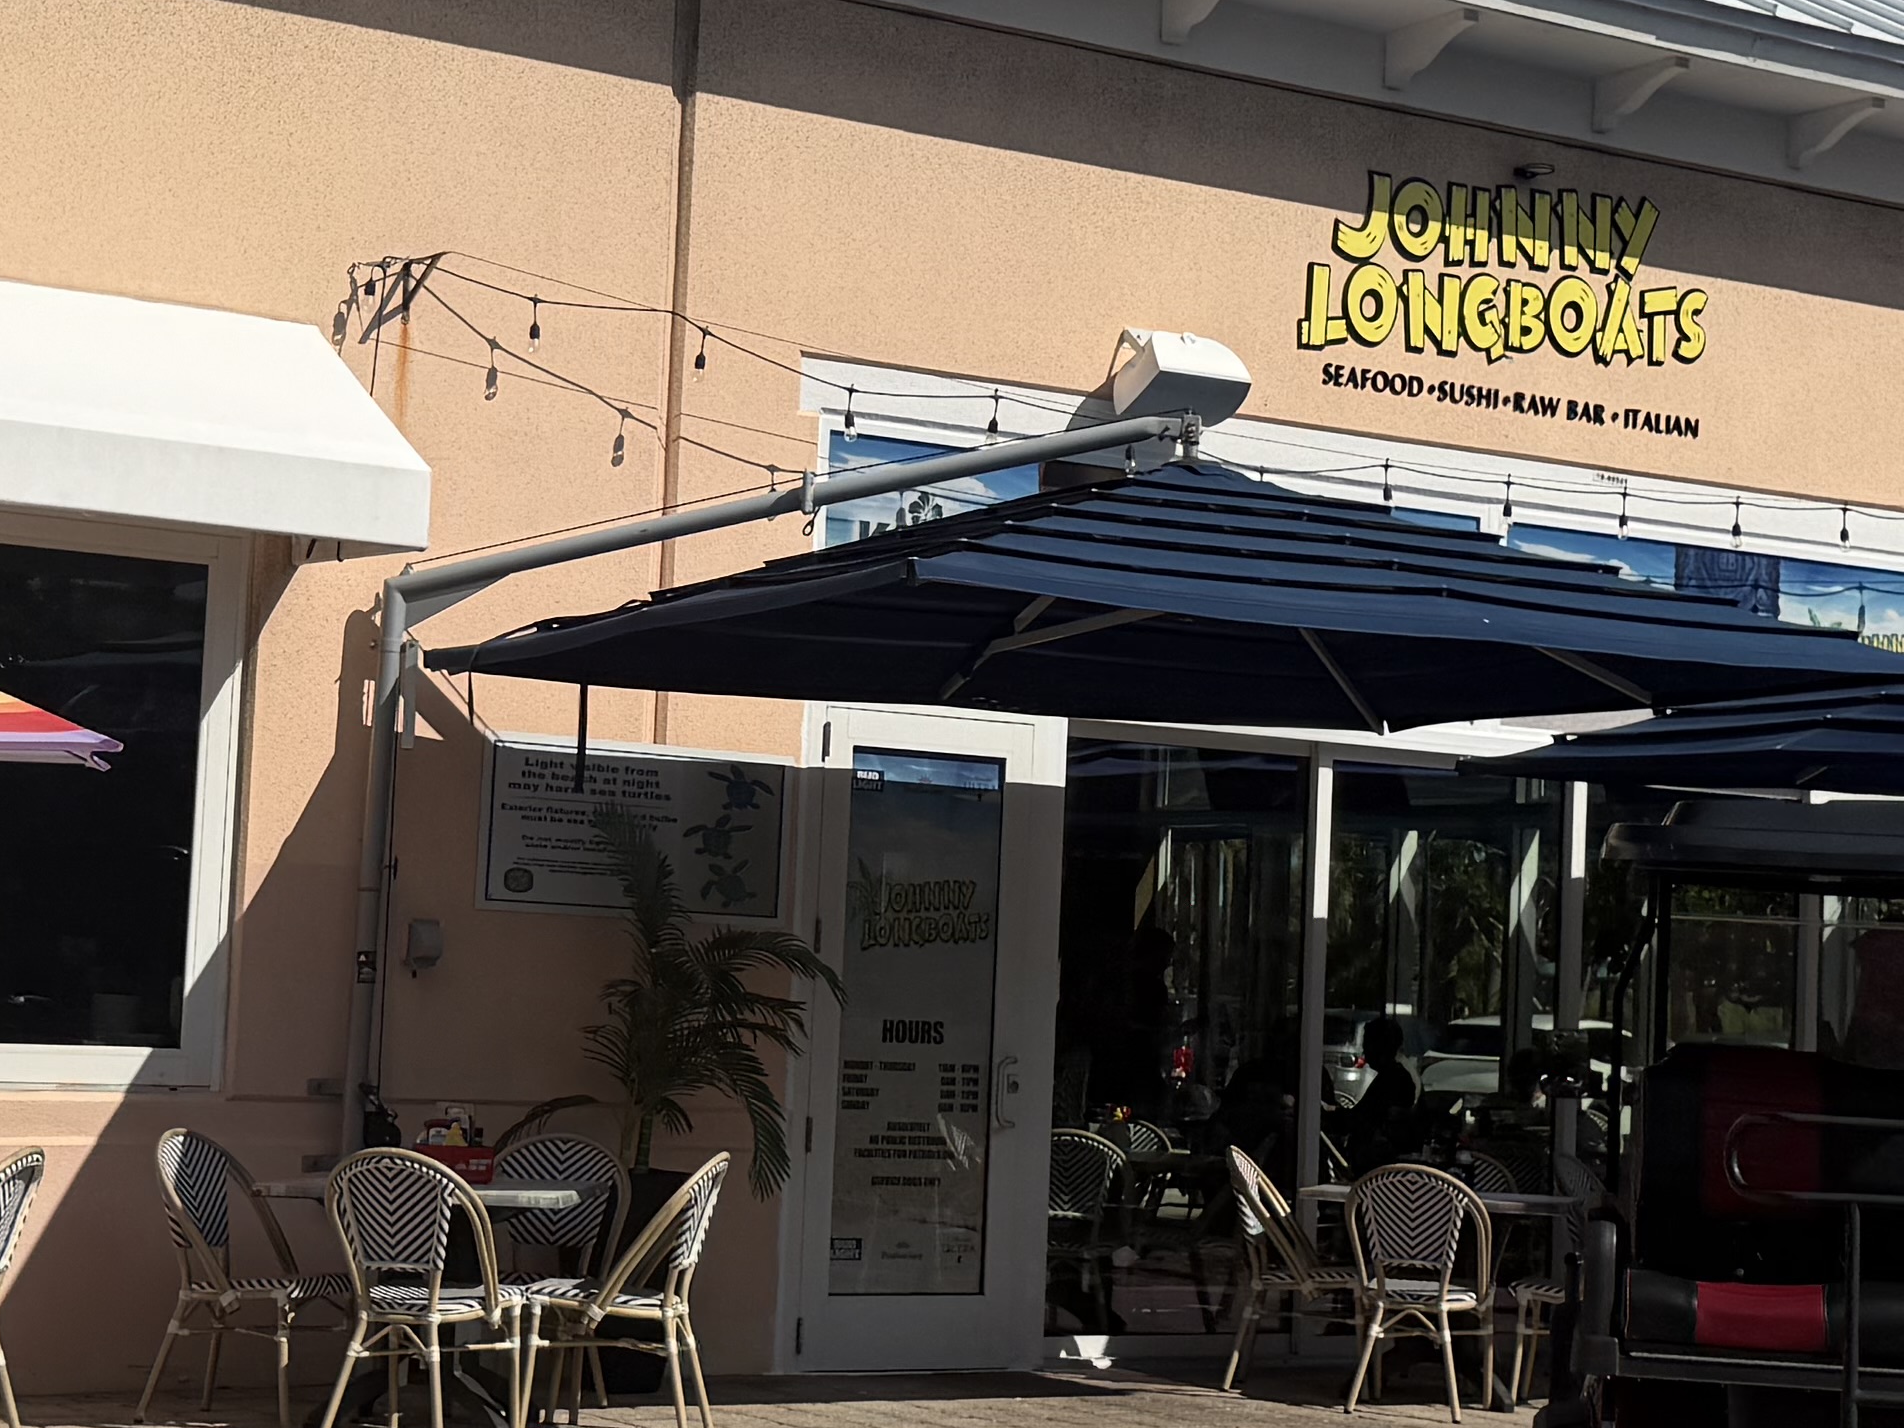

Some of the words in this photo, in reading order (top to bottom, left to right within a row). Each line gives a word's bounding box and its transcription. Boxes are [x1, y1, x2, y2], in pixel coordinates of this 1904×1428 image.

[1332, 170, 1661, 279] JOHNNY
[1297, 262, 1709, 368] LONGBOATS
[1321, 362, 1424, 400] SEAFOOD
[1437, 380, 1499, 410] SUSHI
[1513, 392, 1561, 420] RAW
[1566, 399, 1606, 427] BAR
[1622, 408, 1700, 440] ITALIAN
[521, 770, 546, 780] the
[603, 777, 617, 786] at
[623, 778, 660, 790] night
[525, 757, 564, 771] Light
[625, 766, 659, 778] from
[508, 782, 539, 793] may
[621, 790, 672, 801] turtles
[874, 879, 977, 916] JOHNNY
[860, 910, 990, 951] LONGBOATS
[882, 1018, 945, 1045] HOURS
